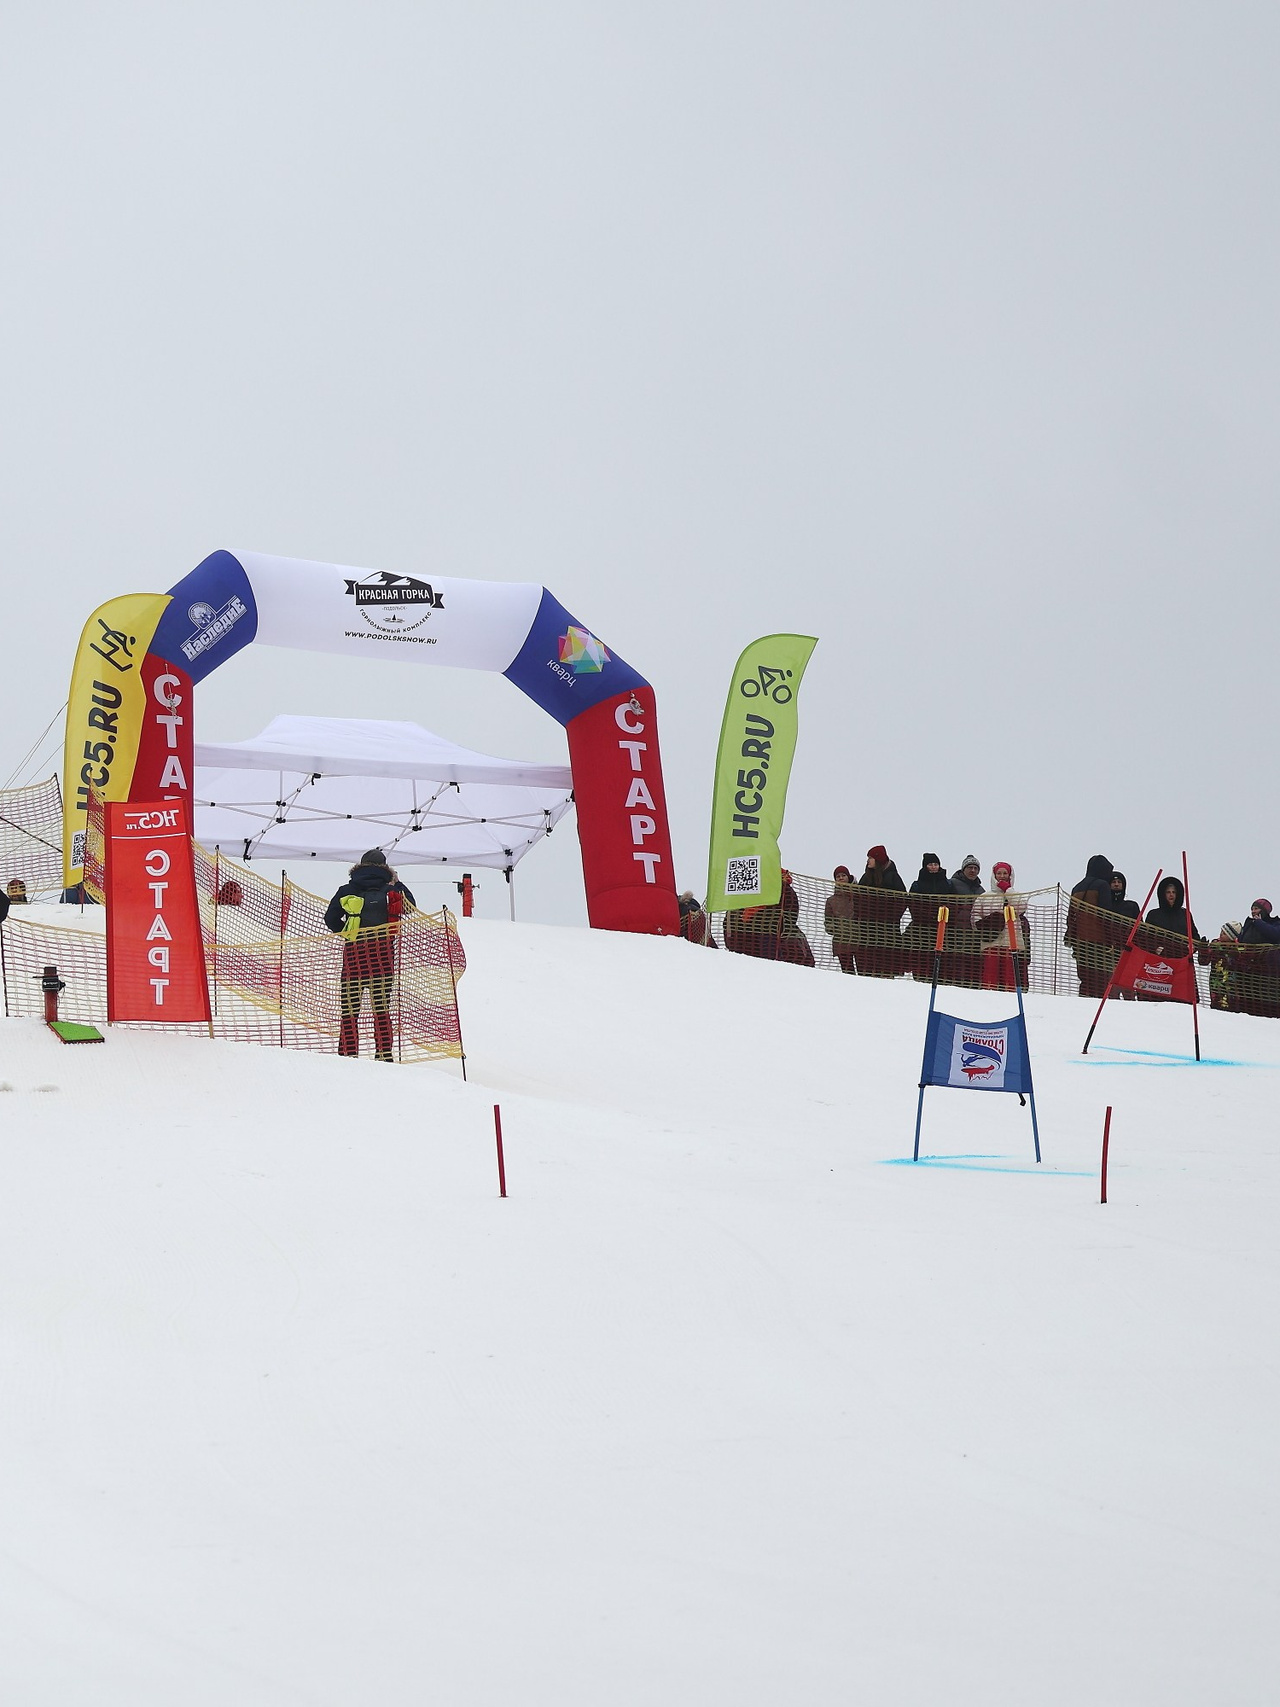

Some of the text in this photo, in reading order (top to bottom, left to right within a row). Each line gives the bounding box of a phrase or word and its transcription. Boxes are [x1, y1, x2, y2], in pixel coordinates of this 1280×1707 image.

[358, 588, 430, 600] КРАСНАЯ ГОРКА
[359, 608, 432, 633] ГОРНОЛЫЖНЫЙ КОМПЛЕКС
[344, 631, 438, 645] WWW.PODOLSKSNOW.RU
[546, 659, 577, 688] кварц
[732, 713, 775, 839] HC5.RU
[614, 702, 662, 885] СТАРТ
[962, 1034, 1005, 1056] СТОЛИЦА
